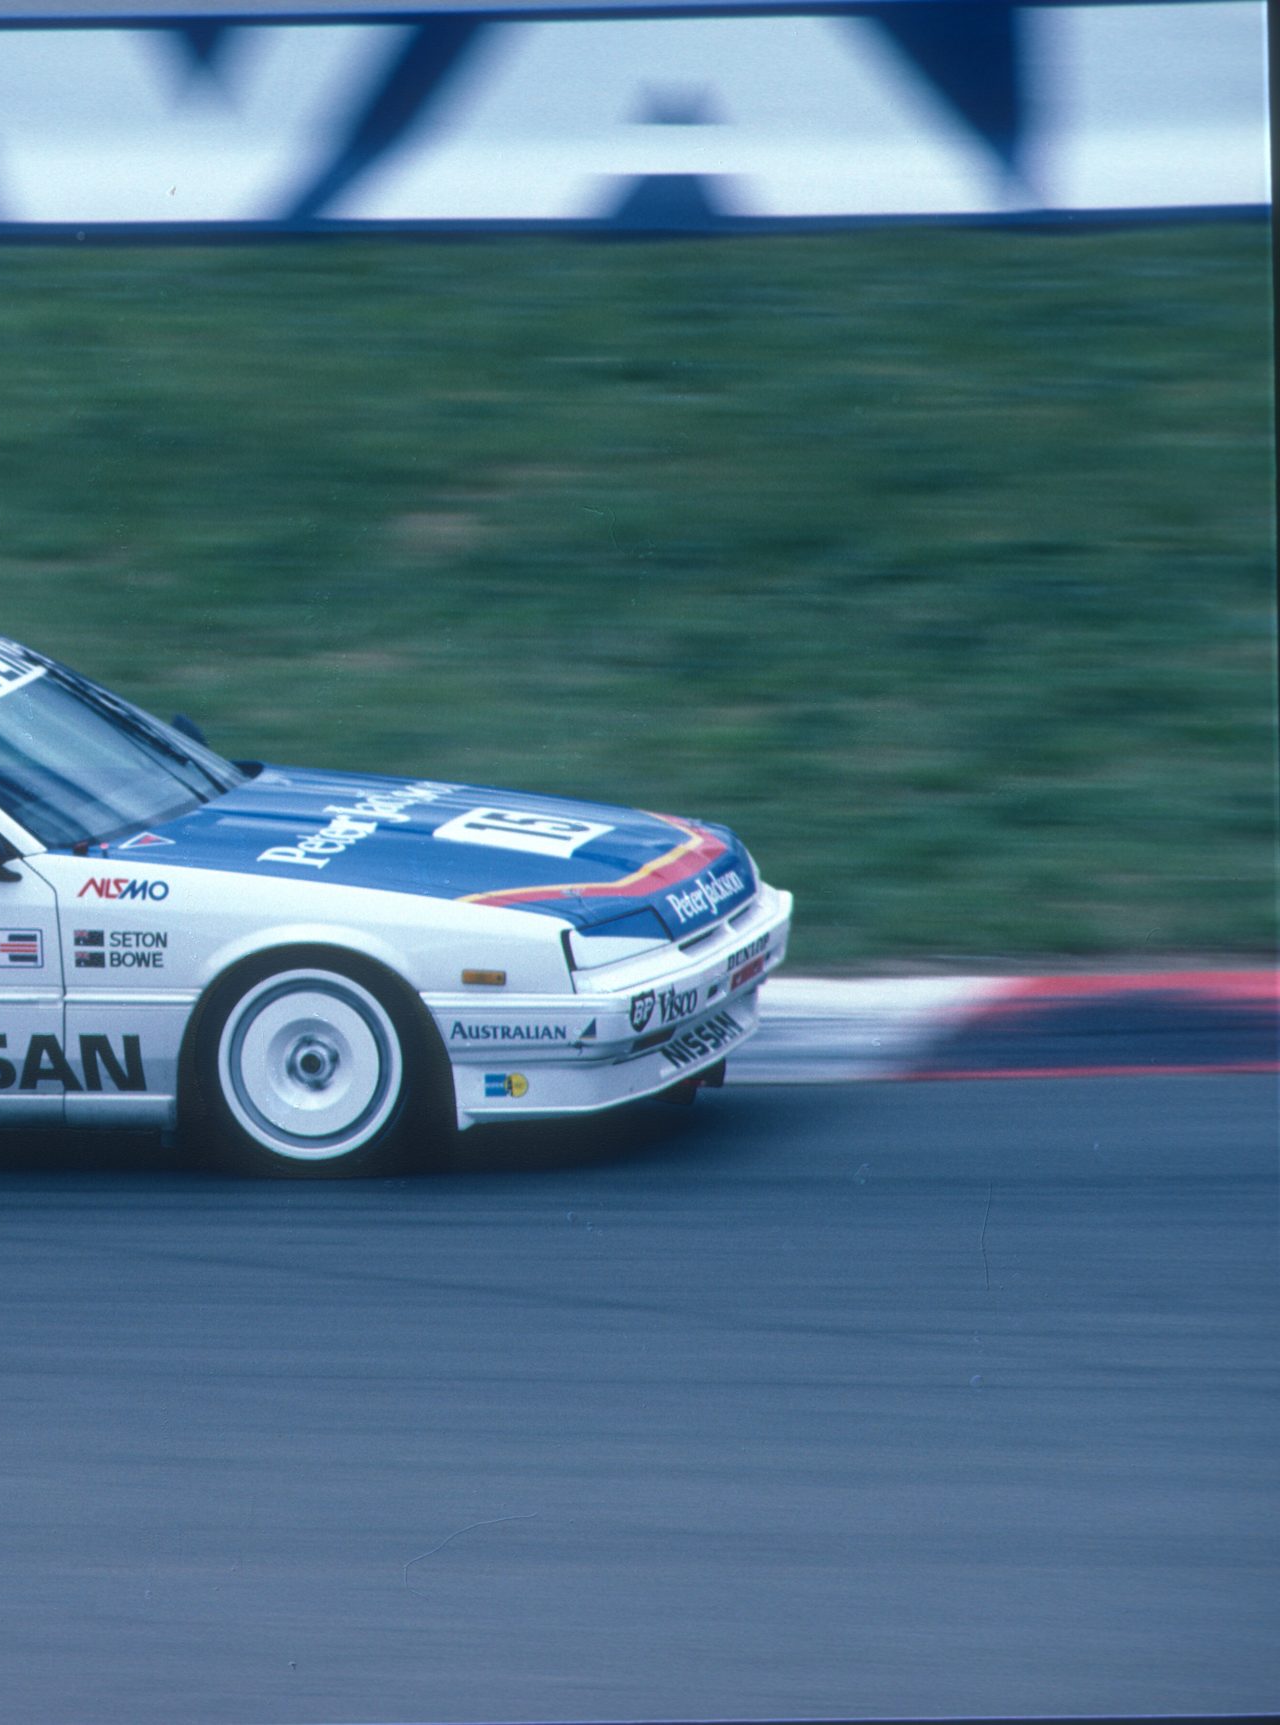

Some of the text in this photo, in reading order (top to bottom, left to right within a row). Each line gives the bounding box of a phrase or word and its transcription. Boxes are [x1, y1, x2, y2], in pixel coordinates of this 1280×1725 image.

[463, 811, 591, 841] 15
[256, 814, 378, 869] Peter
[77, 877, 170, 901] NISMO
[665, 870, 745, 923] Peter Jackson
[109, 931, 168, 948] SETON
[726, 931, 769, 971] DUNLOP
[109, 951, 164, 968] BOWE
[631, 995, 655, 1026] BP
[450, 1020, 567, 1040] AUSTRALIAN
[660, 1010, 745, 1069] NISSAN
